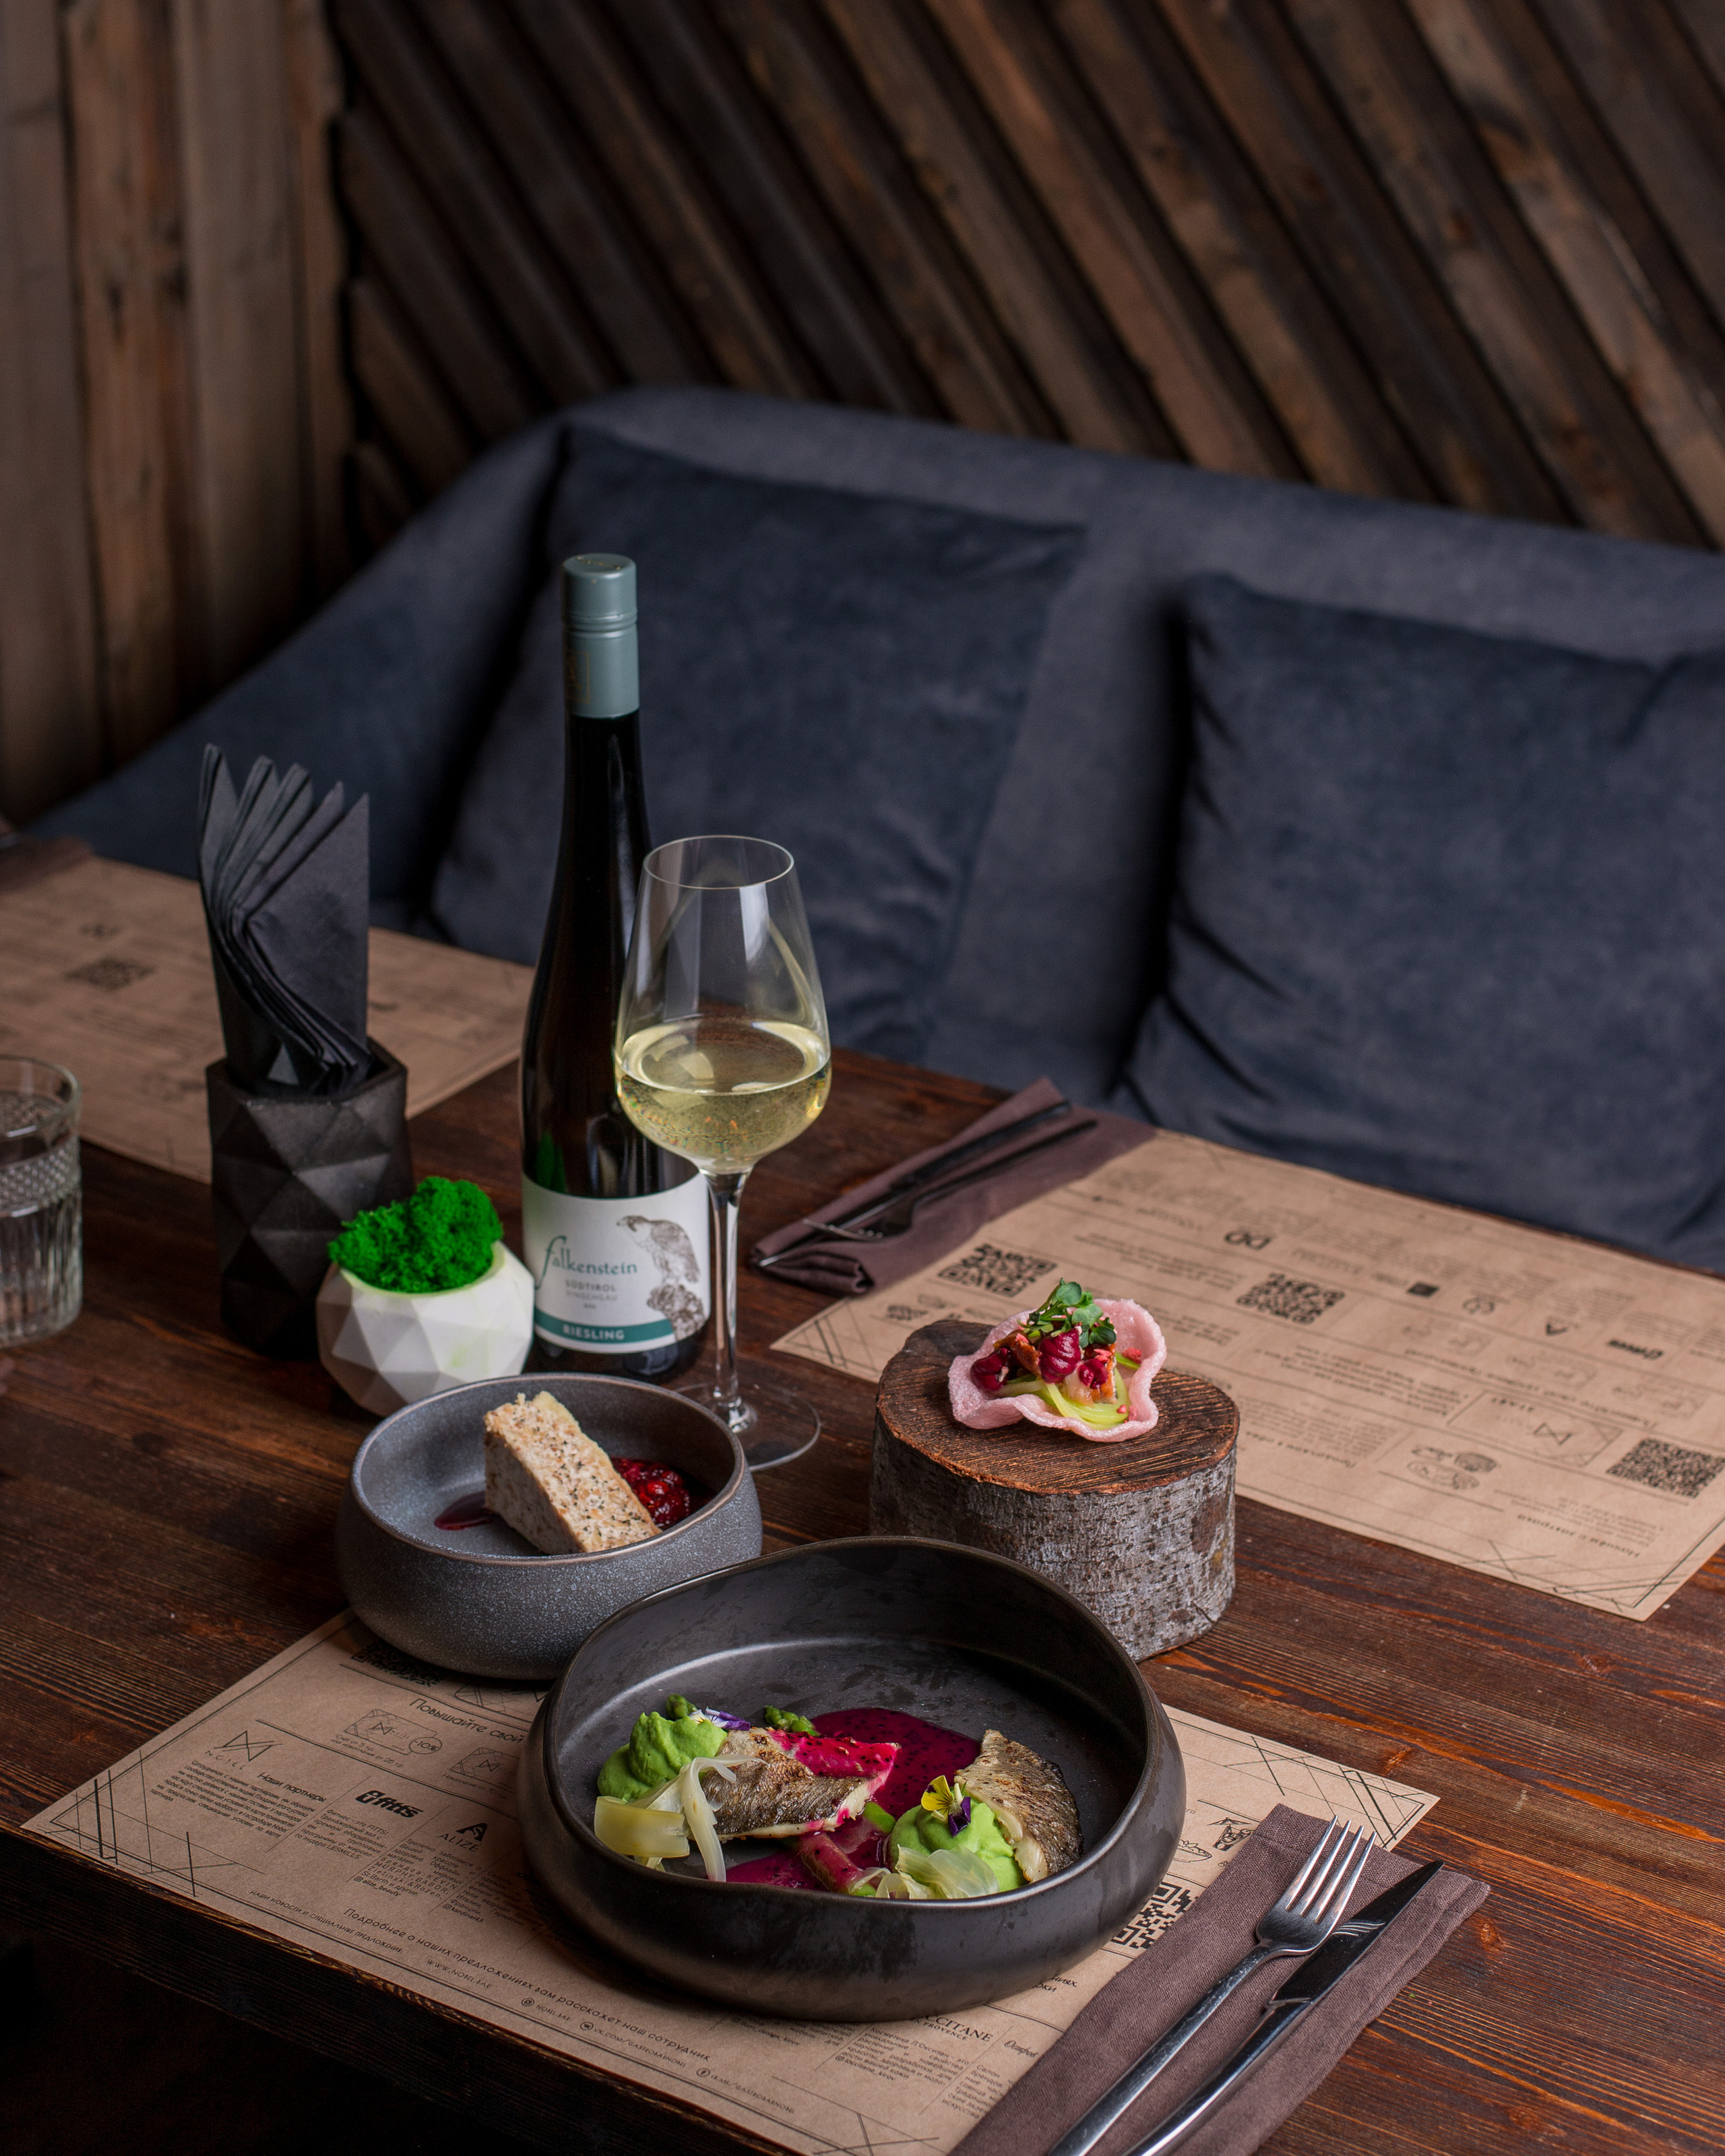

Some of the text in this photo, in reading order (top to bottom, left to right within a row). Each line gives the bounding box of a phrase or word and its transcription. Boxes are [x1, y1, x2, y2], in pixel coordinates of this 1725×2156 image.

[563, 1325, 625, 1340] RIESLING
[410, 1699, 526, 1744] Повышайте свой
[257, 1773, 326, 1802] Наши партнеры
[314, 1820, 386, 1848] премиум оборудовани-
[321, 1814, 365, 1833] Тренажерный
[327, 1810, 350, 1820] Фитнес
[367, 1825, 389, 1835] FITTS!
[301, 1829, 337, 1843] программы
[348, 1846, 373, 1857] мирово-
[302, 1837, 326, 1847] лидера
[327, 1845, 360, 1860] LESMILLS.
[347, 1839, 381, 1853] групповые
[406, 1839, 473, 1867] Трепетно заботимся
[393, 1849, 460, 1876] здоровье. Оффлайн
[400, 1843, 458, 1868] Вашей красоте
[387, 1853, 463, 1884] магазин мировых
[394, 1885, 418, 1896] другие.
[250, 1891, 270, 1900] НАШИ
[270, 1898, 302, 1912] НОВОСТИ
[310, 1914, 354, 1934] СПЕЦИАЛЬНЫЕ
[450, 1907, 484, 1922] kardinal43
[451, 1899, 480, 1915] Франции.
[491, 1909, 524, 1926] Германии
[344, 1909, 406, 1937] Подробнее
[416, 1939, 451, 1955] наших
[453, 1954, 533, 1989] предложениях
[534, 1988, 556, 1998] вам
[556, 1997, 621, 2024] расскажет
[622, 2023, 646, 2035] наш
[648, 2034, 710, 2061] сотрудник
[790, 2027, 815, 2038] мебель
[871, 2027, 909, 2043] Косметика
[924, 2022, 966, 2039] PROVENCE
[853, 2042, 884, 2054] научные
[889, 2055, 932, 2072] разработки
[858, 2037, 958, 2075] растений новейшие
[864, 2033, 963, 2070] уникальные свойства
[841, 2052, 909, 2078] дости вашей кожи
[881, 2058, 915, 2074] здоровья
[977, 2065, 1000, 2078] Салон
[960, 2082, 986, 2096] глянца
[966, 2076, 980, 2085] ные
[948, 2094, 966, 2103] ские
